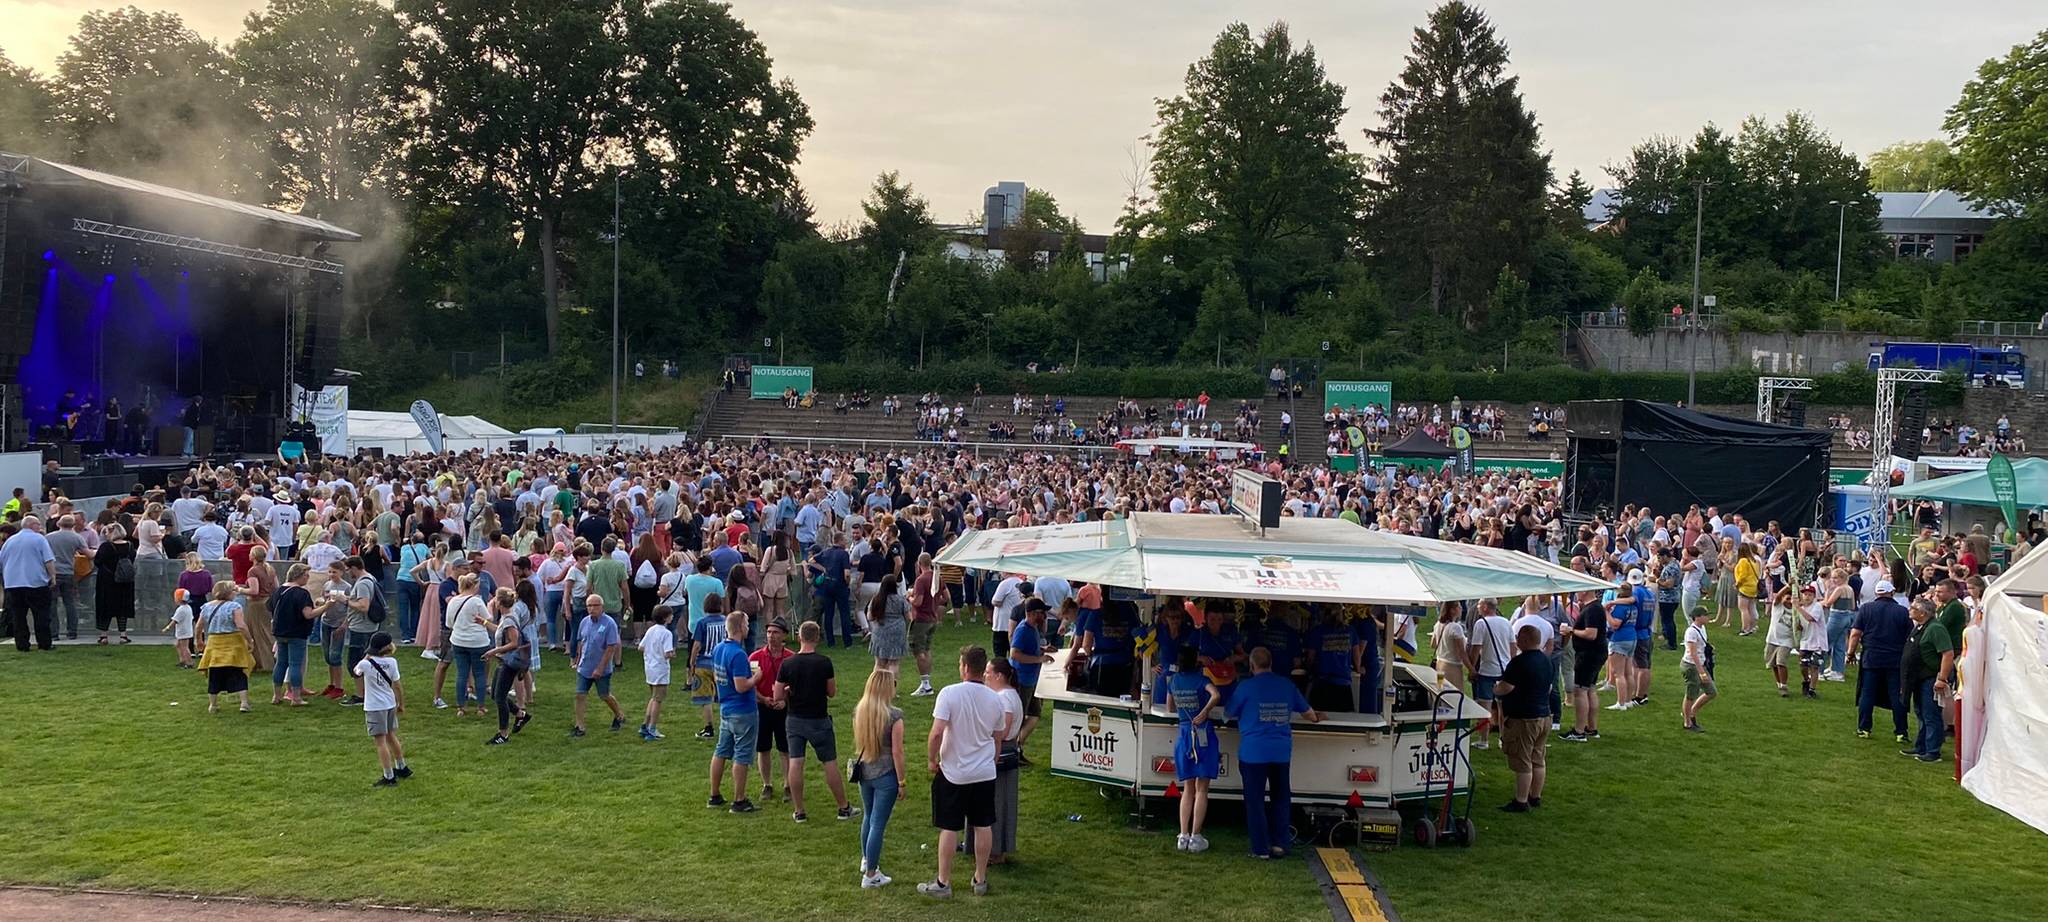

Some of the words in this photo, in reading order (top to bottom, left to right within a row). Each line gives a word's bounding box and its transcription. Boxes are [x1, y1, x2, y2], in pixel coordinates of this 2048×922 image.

[754, 368, 810, 377] NOTAUSGANG
[1328, 383, 1389, 392] NOTAUSGANG
[1070, 725, 1119, 755] Zunft
[1082, 751, 1114, 767] KÖLSCH
[1421, 770, 1450, 781] KLSCH
